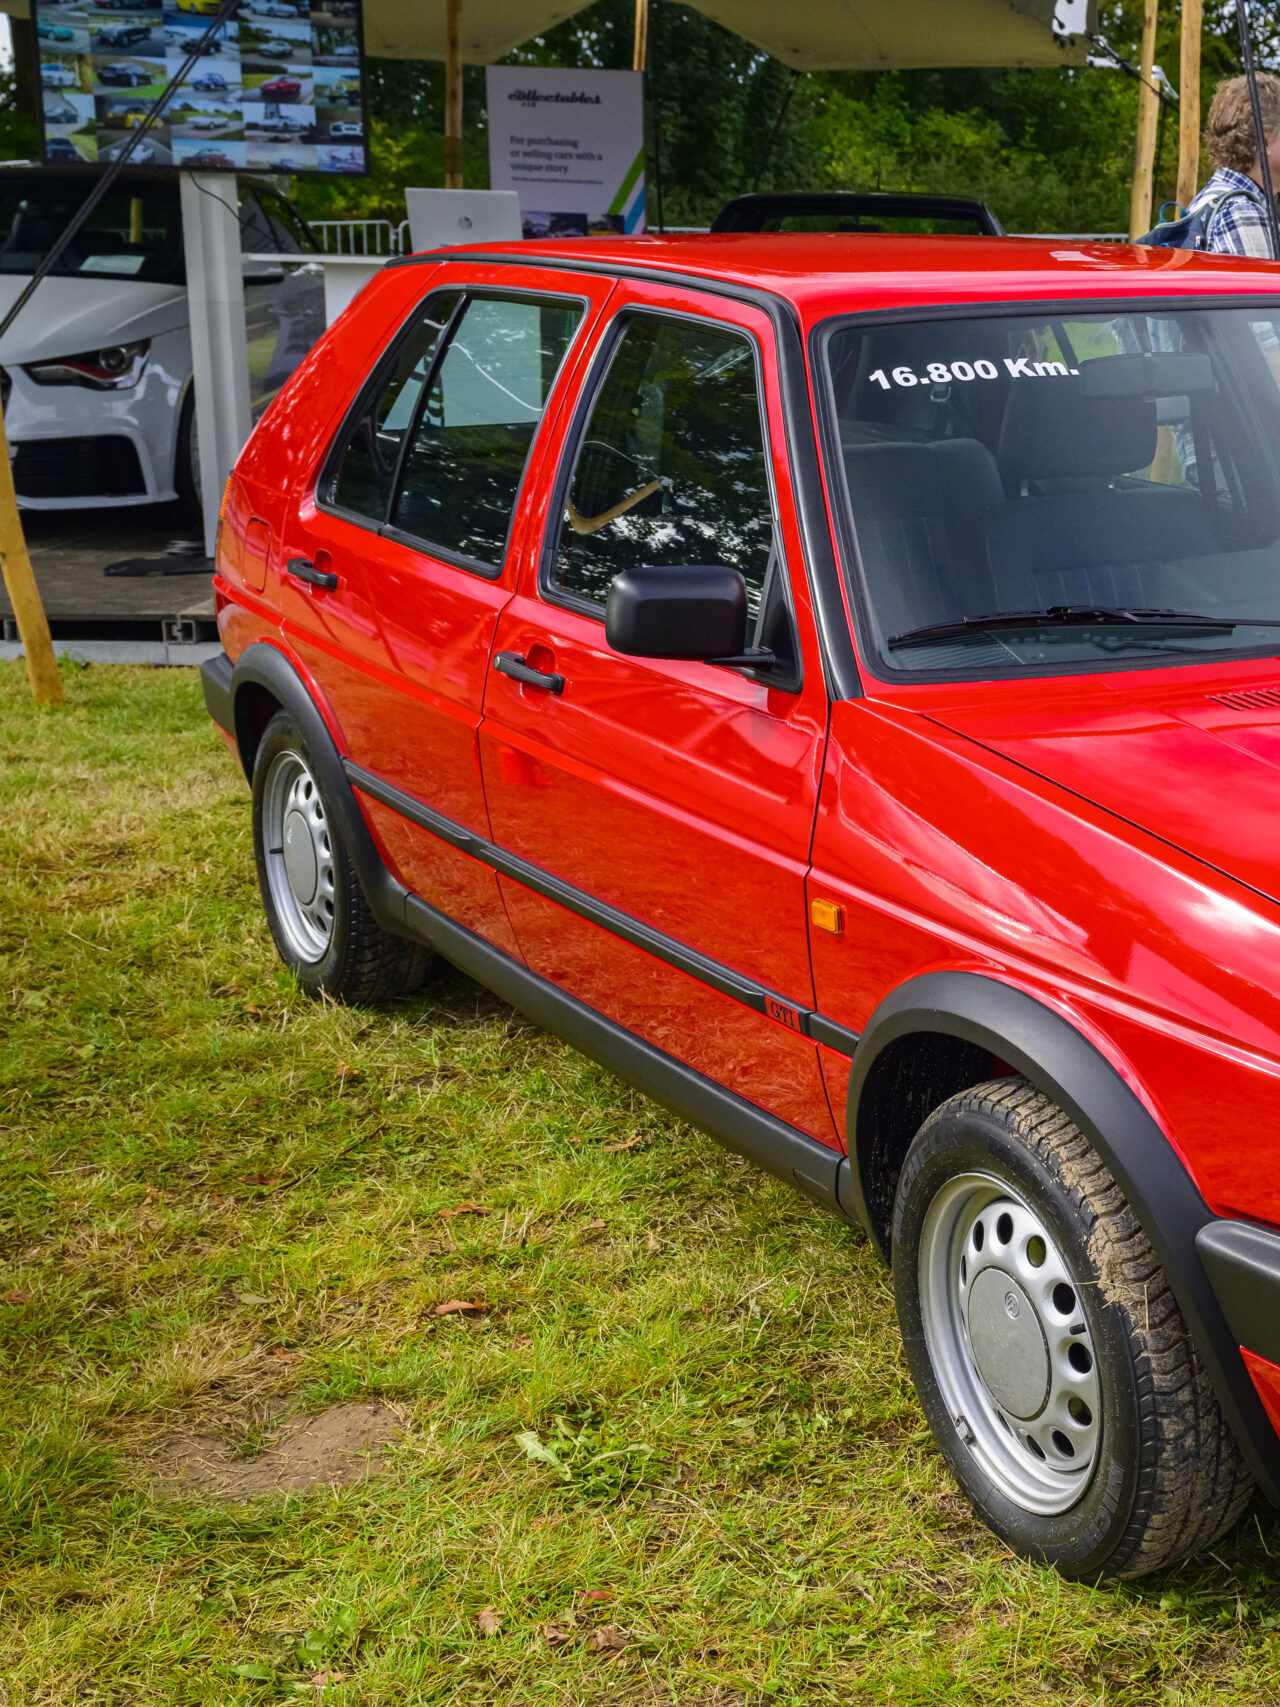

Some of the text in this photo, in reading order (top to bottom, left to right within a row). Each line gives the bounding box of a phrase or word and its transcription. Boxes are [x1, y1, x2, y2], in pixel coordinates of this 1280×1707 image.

[510, 136, 578, 149] For purchasing
[510, 150, 603, 161] or selling cars with a
[511, 163, 543, 173] unique
[868, 357, 1081, 391] 16.800 Km.
[770, 1001, 795, 1027] GTI
